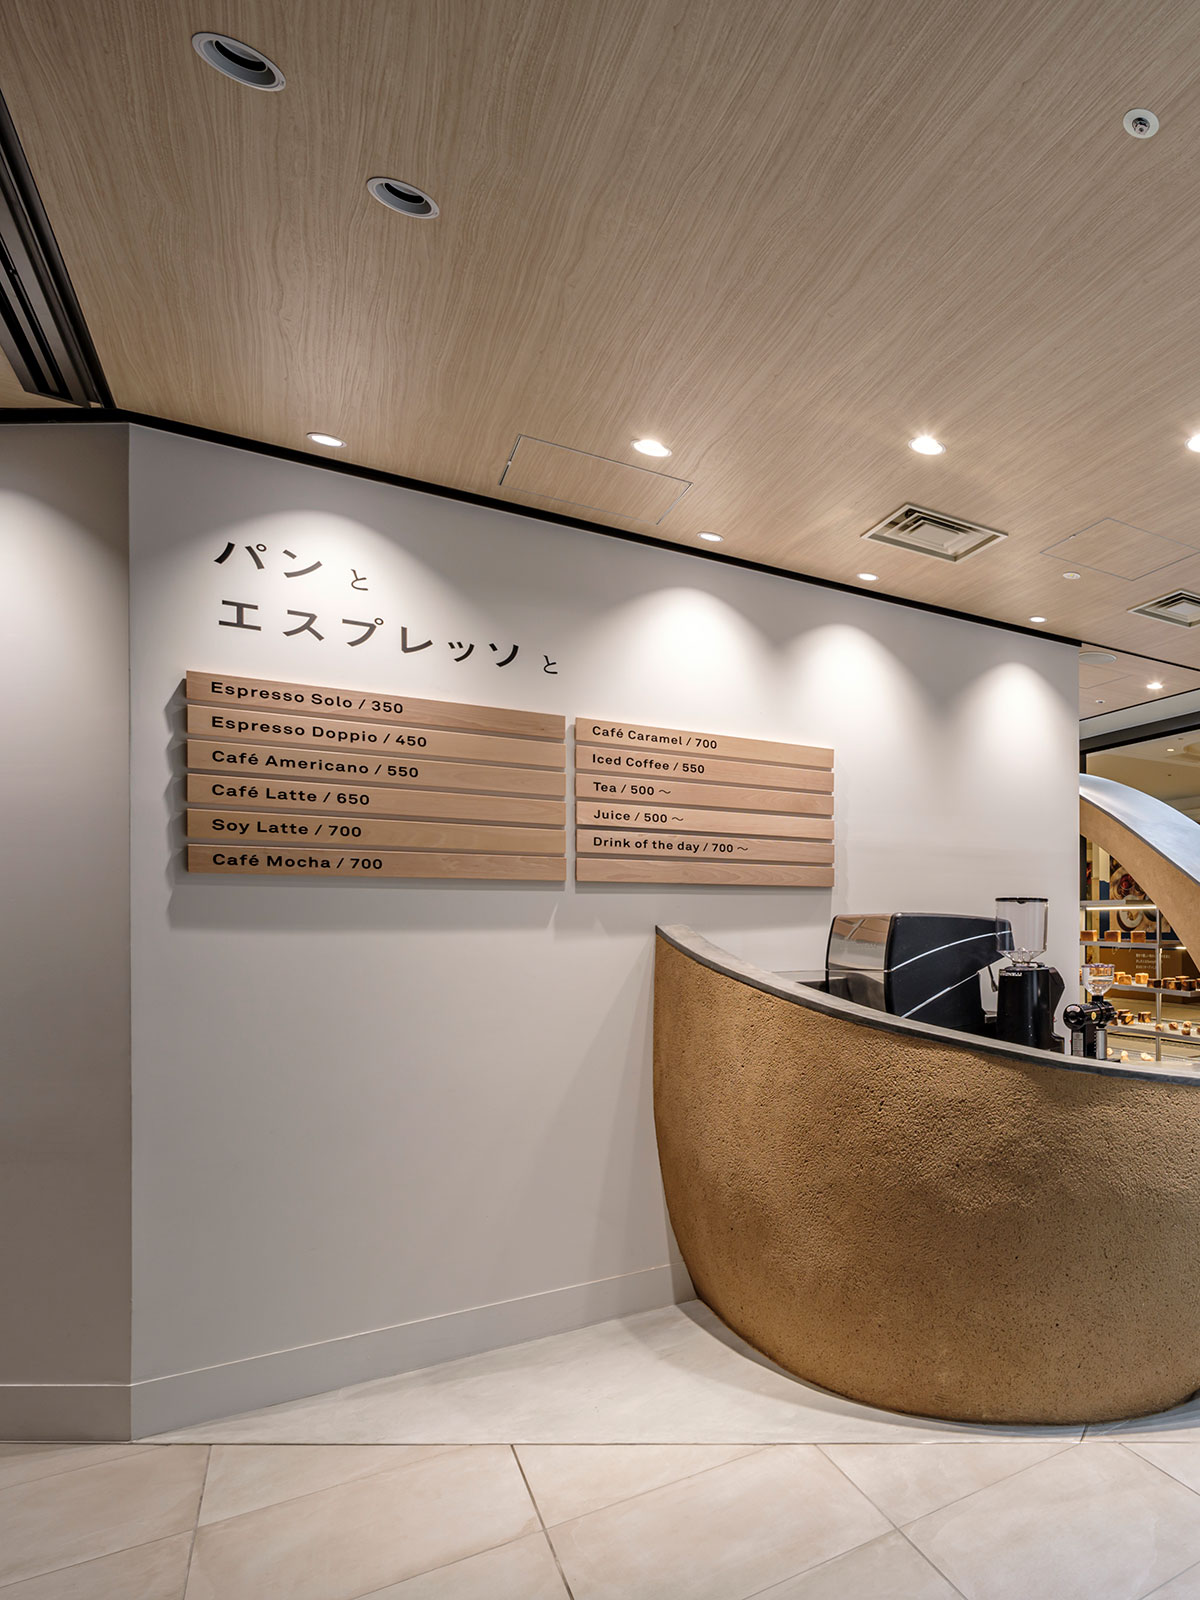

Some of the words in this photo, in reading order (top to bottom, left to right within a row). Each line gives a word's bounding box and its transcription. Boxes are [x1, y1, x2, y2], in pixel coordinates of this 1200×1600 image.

[211, 681, 304, 703] Espresso
[311, 693, 352, 708] Solo
[371, 701, 403, 714] 350
[211, 716, 305, 738] Espresso
[312, 727, 378, 744] Doppio
[395, 735, 427, 747] 450
[592, 726, 623, 738] Café
[628, 730, 683, 745] Caramel
[695, 739, 717, 749] 700
[212, 751, 259, 766] Café
[265, 756, 369, 775] Americano
[387, 765, 419, 778] 550
[592, 754, 621, 766] Iced
[626, 758, 669, 770] Coffee
[682, 763, 705, 774] 550
[212, 784, 259, 798] Café
[266, 788, 317, 802] Latte
[336, 793, 369, 805] 650
[593, 782, 617, 794] Tea
[631, 785, 654, 796] 500
[594, 810, 630, 821] Juice
[644, 813, 667, 823] 500
[212, 819, 250, 835] Soy
[257, 822, 308, 835] Latte
[328, 826, 361, 837] 700
[594, 837, 631, 848] Drink
[635, 839, 649, 849] of
[652, 840, 673, 850] the
[677, 841, 699, 853] day
[712, 843, 733, 852] 700
[212, 854, 259, 867] Café
[267, 856, 331, 869] Mocha
[350, 858, 382, 870] 700
